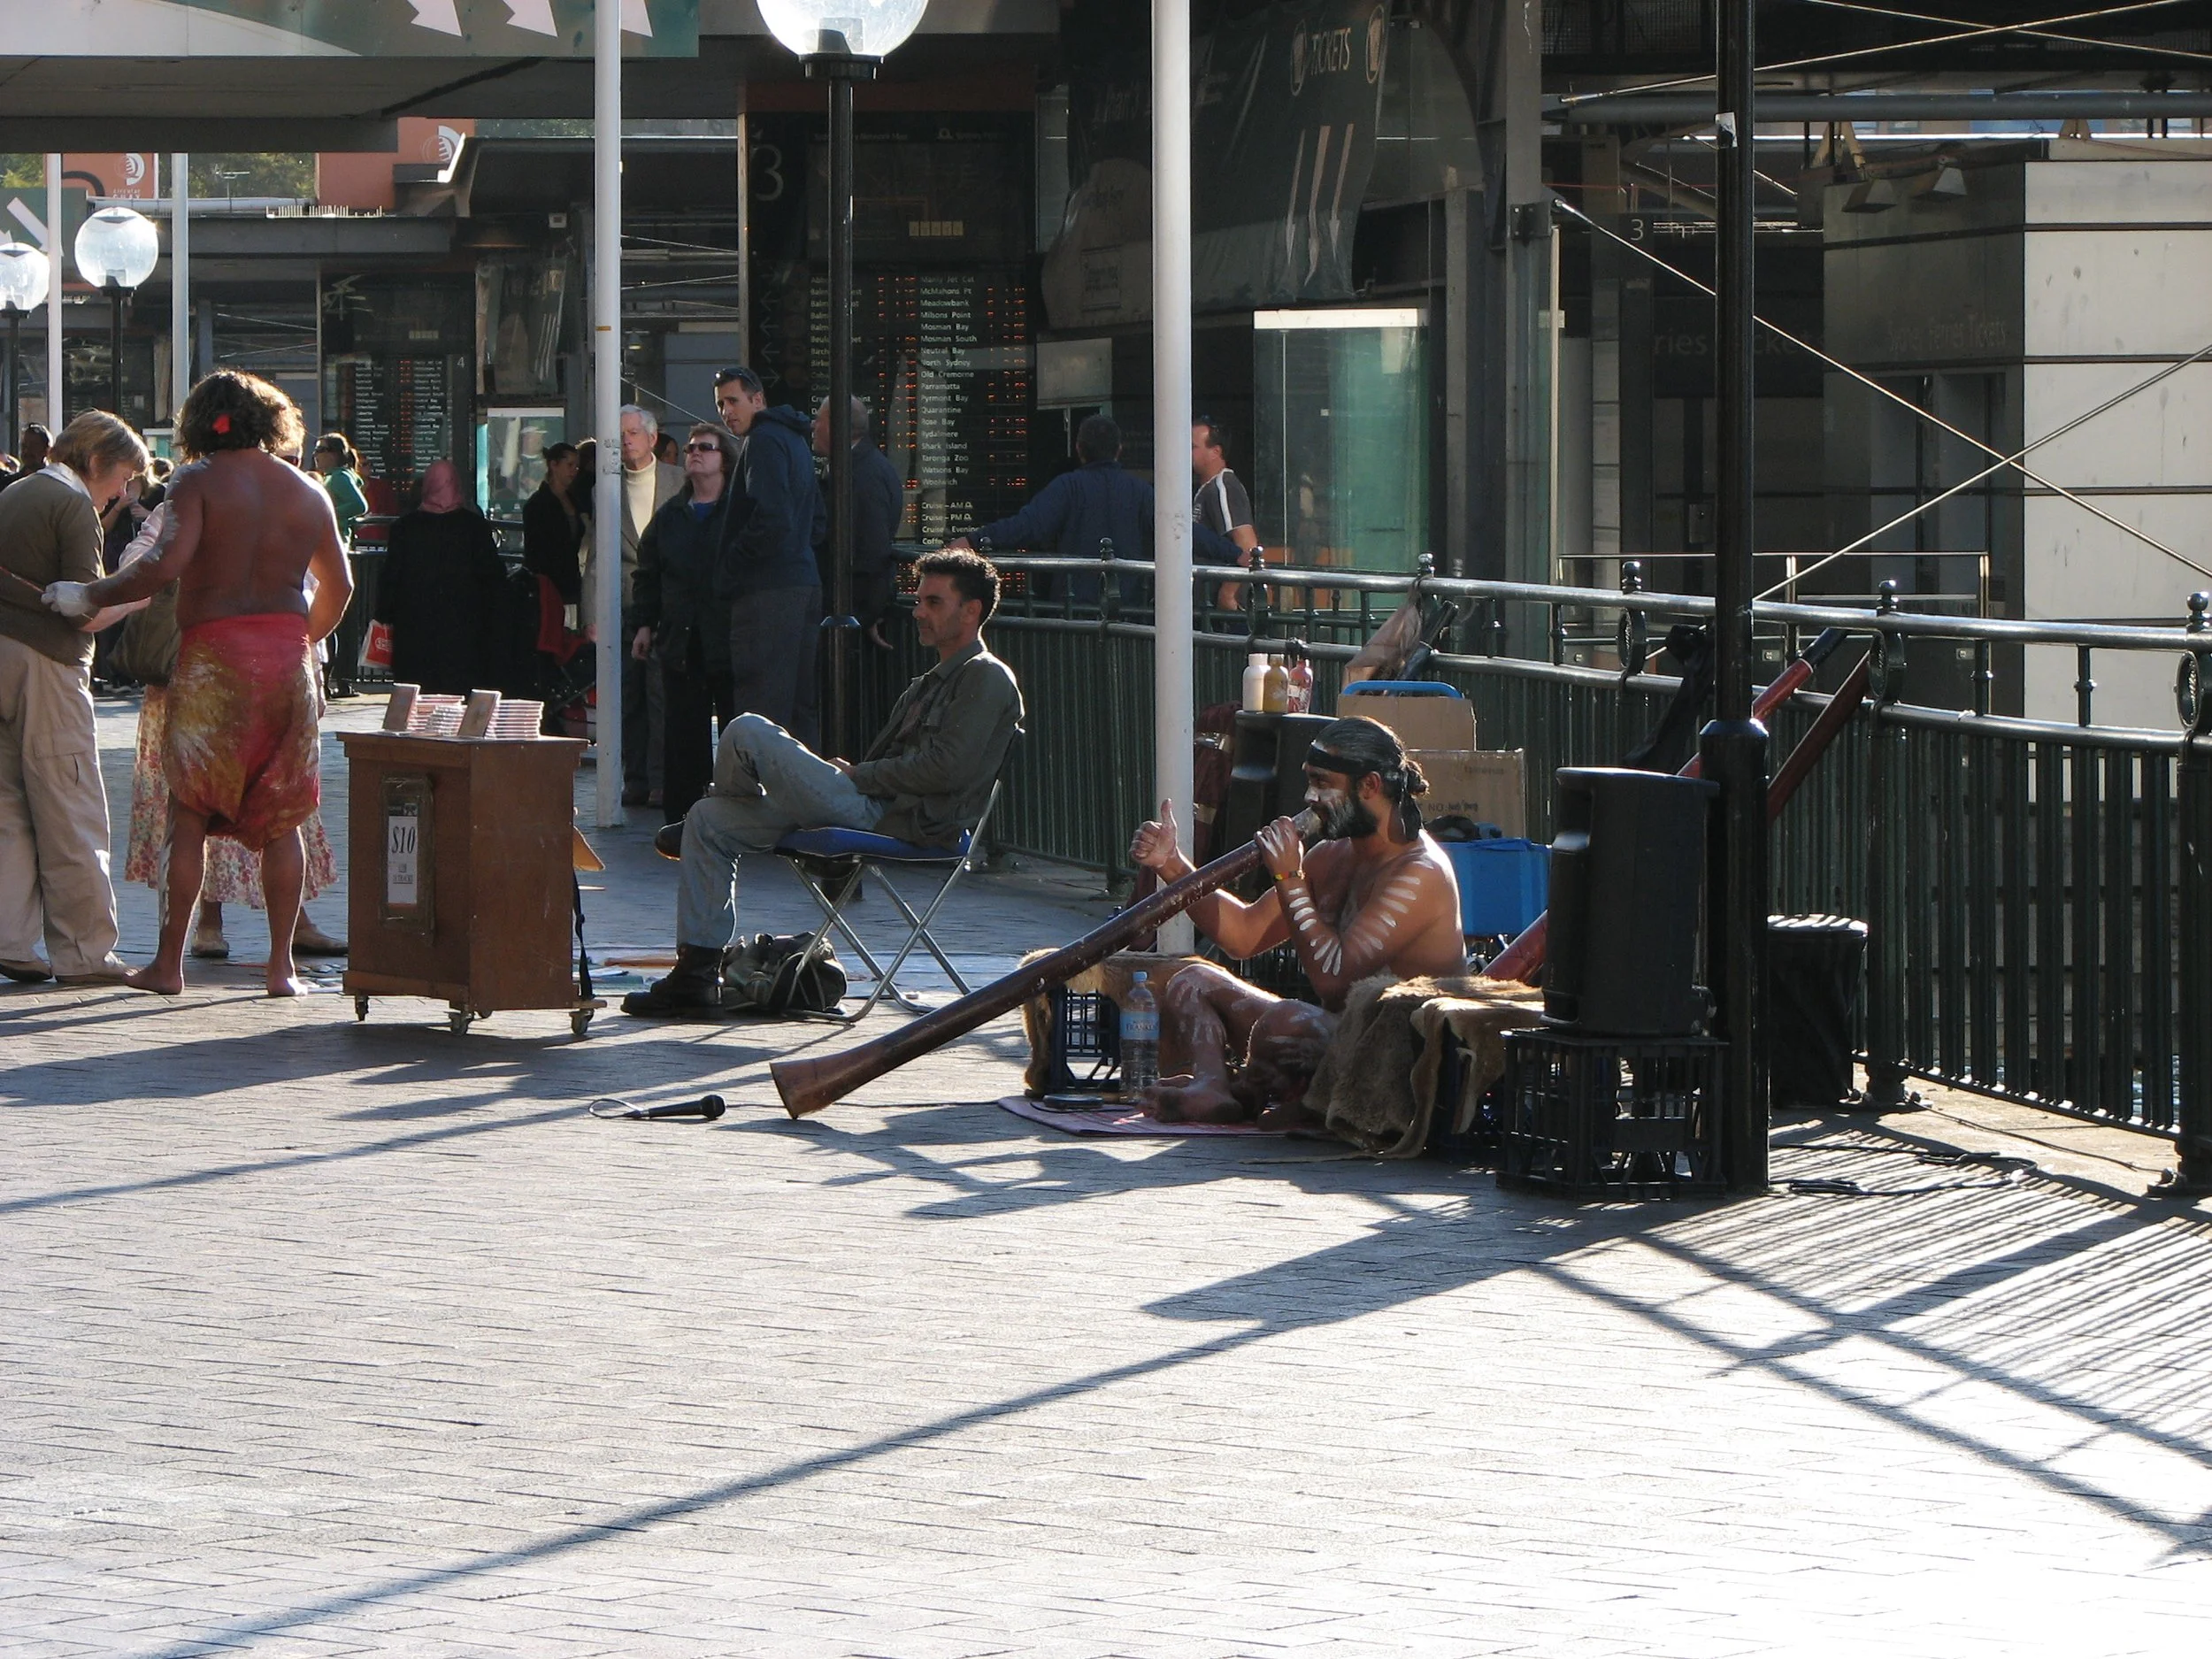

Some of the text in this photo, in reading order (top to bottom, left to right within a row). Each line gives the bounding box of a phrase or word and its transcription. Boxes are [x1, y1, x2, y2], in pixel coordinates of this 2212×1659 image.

[1310, 27, 1352, 76] TICKETS
[754, 144, 785, 201] 3
[1630, 219, 1644, 242] 3
[956, 323, 970, 332] Bay
[457, 357, 465, 369] 4
[955, 395, 969, 403] Bay
[921, 455, 951, 464] Taronga
[956, 466, 970, 475] Bay
